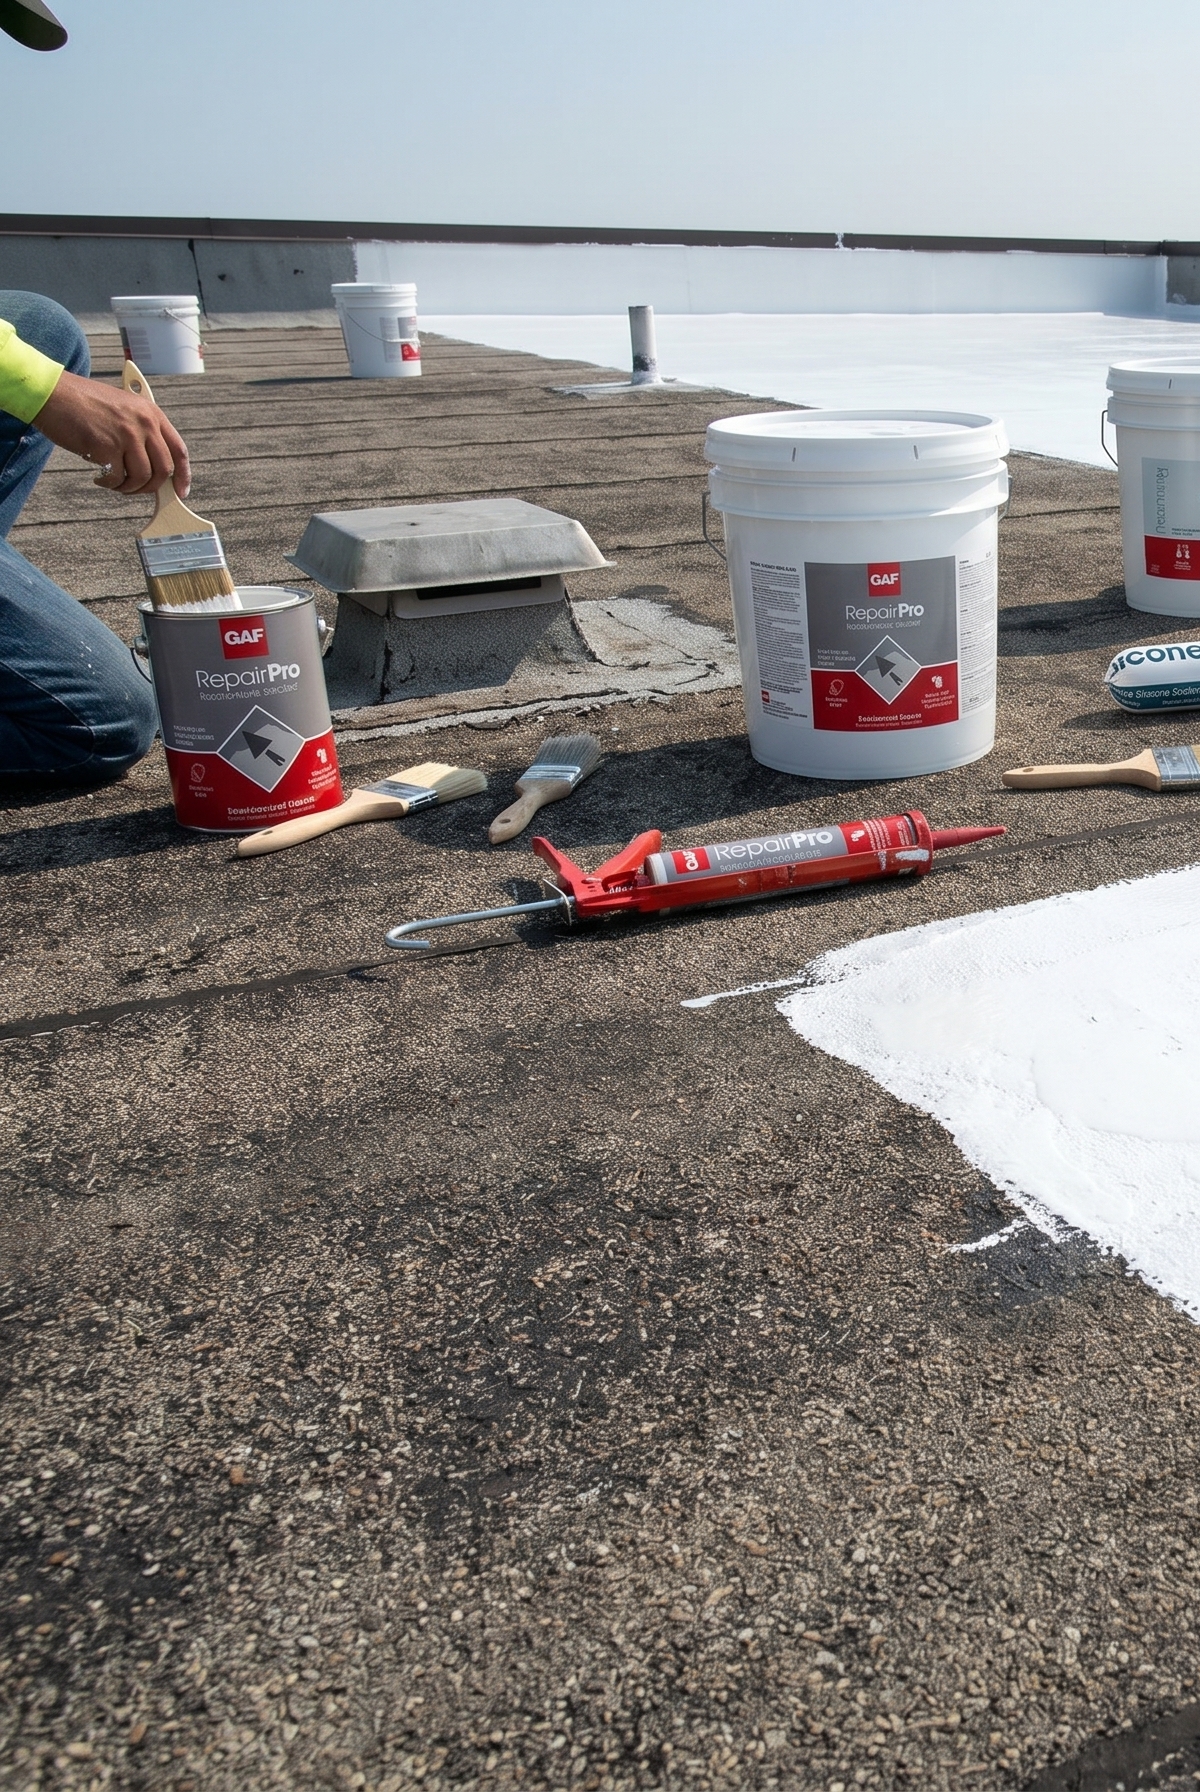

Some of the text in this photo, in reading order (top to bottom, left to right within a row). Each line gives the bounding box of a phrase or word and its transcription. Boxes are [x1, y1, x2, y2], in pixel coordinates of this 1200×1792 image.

[870, 573, 899, 586] GAF
[845, 602, 925, 623] RepairPro
[224, 628, 264, 645] GAF
[195, 662, 300, 692] RepairPro
